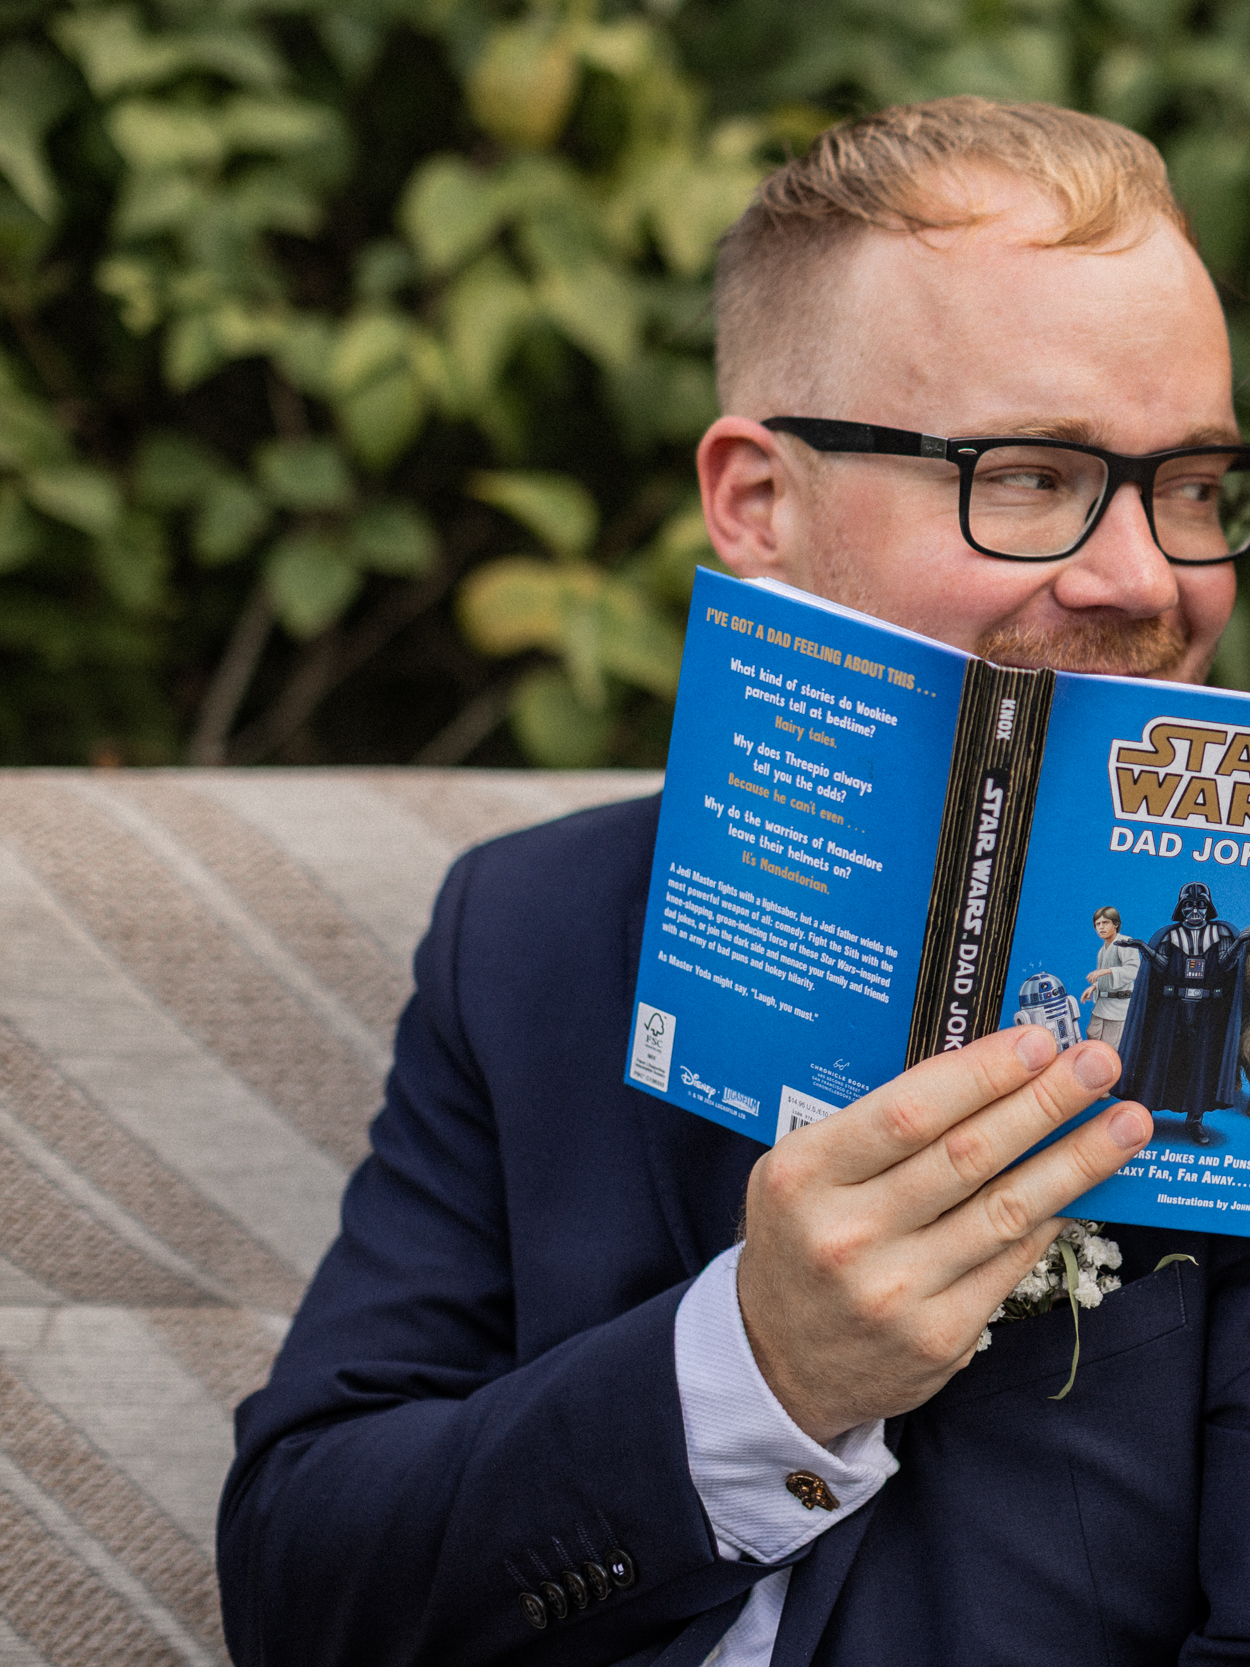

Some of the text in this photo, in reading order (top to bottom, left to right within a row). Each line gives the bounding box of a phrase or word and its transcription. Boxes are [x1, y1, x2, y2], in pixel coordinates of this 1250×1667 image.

[730, 615, 754, 635] GOT
[755, 624, 763, 639] A
[766, 627, 791, 648] DAD
[793, 636, 841, 665] FEELING
[843, 654, 885, 679] ABOUT
[887, 667, 915, 689] THIS
[730, 657, 897, 726] What kind of stories do Wookiee
[744, 685, 875, 737] parents tell at bedtime?
[774, 715, 837, 748] Hairy tales.
[996, 699, 1016, 741] KNOX
[733, 732, 872, 795] Why does Threepio always
[753, 759, 846, 802] tell you the odds?
[728, 772, 769, 798] Because
[773, 788, 786, 804] he
[819, 809, 844, 825] even
[704, 794, 882, 871] Why do the warriors of Mandalore
[728, 823, 851, 879] leave their helmets on?
[1110, 827, 1183, 857] DAD
[760, 857, 829, 894] Mandatorian.
[669, 862, 675, 872] A
[676, 865, 691, 878] Jedi
[692, 870, 716, 888] Master
[717, 880, 737, 896] fights
[738, 891, 754, 903] with
[755, 897, 760, 905] a
[761, 897, 798, 921] lightsaber,
[799, 912, 812, 925] but
[819, 920, 835, 934] Jedi
[836, 926, 858, 942] father
[860, 937, 883, 952] wields
[885, 945, 897, 958] the
[944, 778, 1004, 1050] STAR WARS DAD JOK
[657, 950, 667, 961] As
[668, 954, 693, 972] Master
[695, 965, 711, 980] Yoda
[712, 974, 733, 989] might
[734, 983, 748, 996] say,
[778, 1001, 792, 1012] you
[646, 1035, 663, 1048] FSC
[810, 1063, 869, 1090] CHRONICLE BOOKS
[1157, 1193, 1214, 1207] Illustrations
[1216, 1199, 1228, 1210] by
